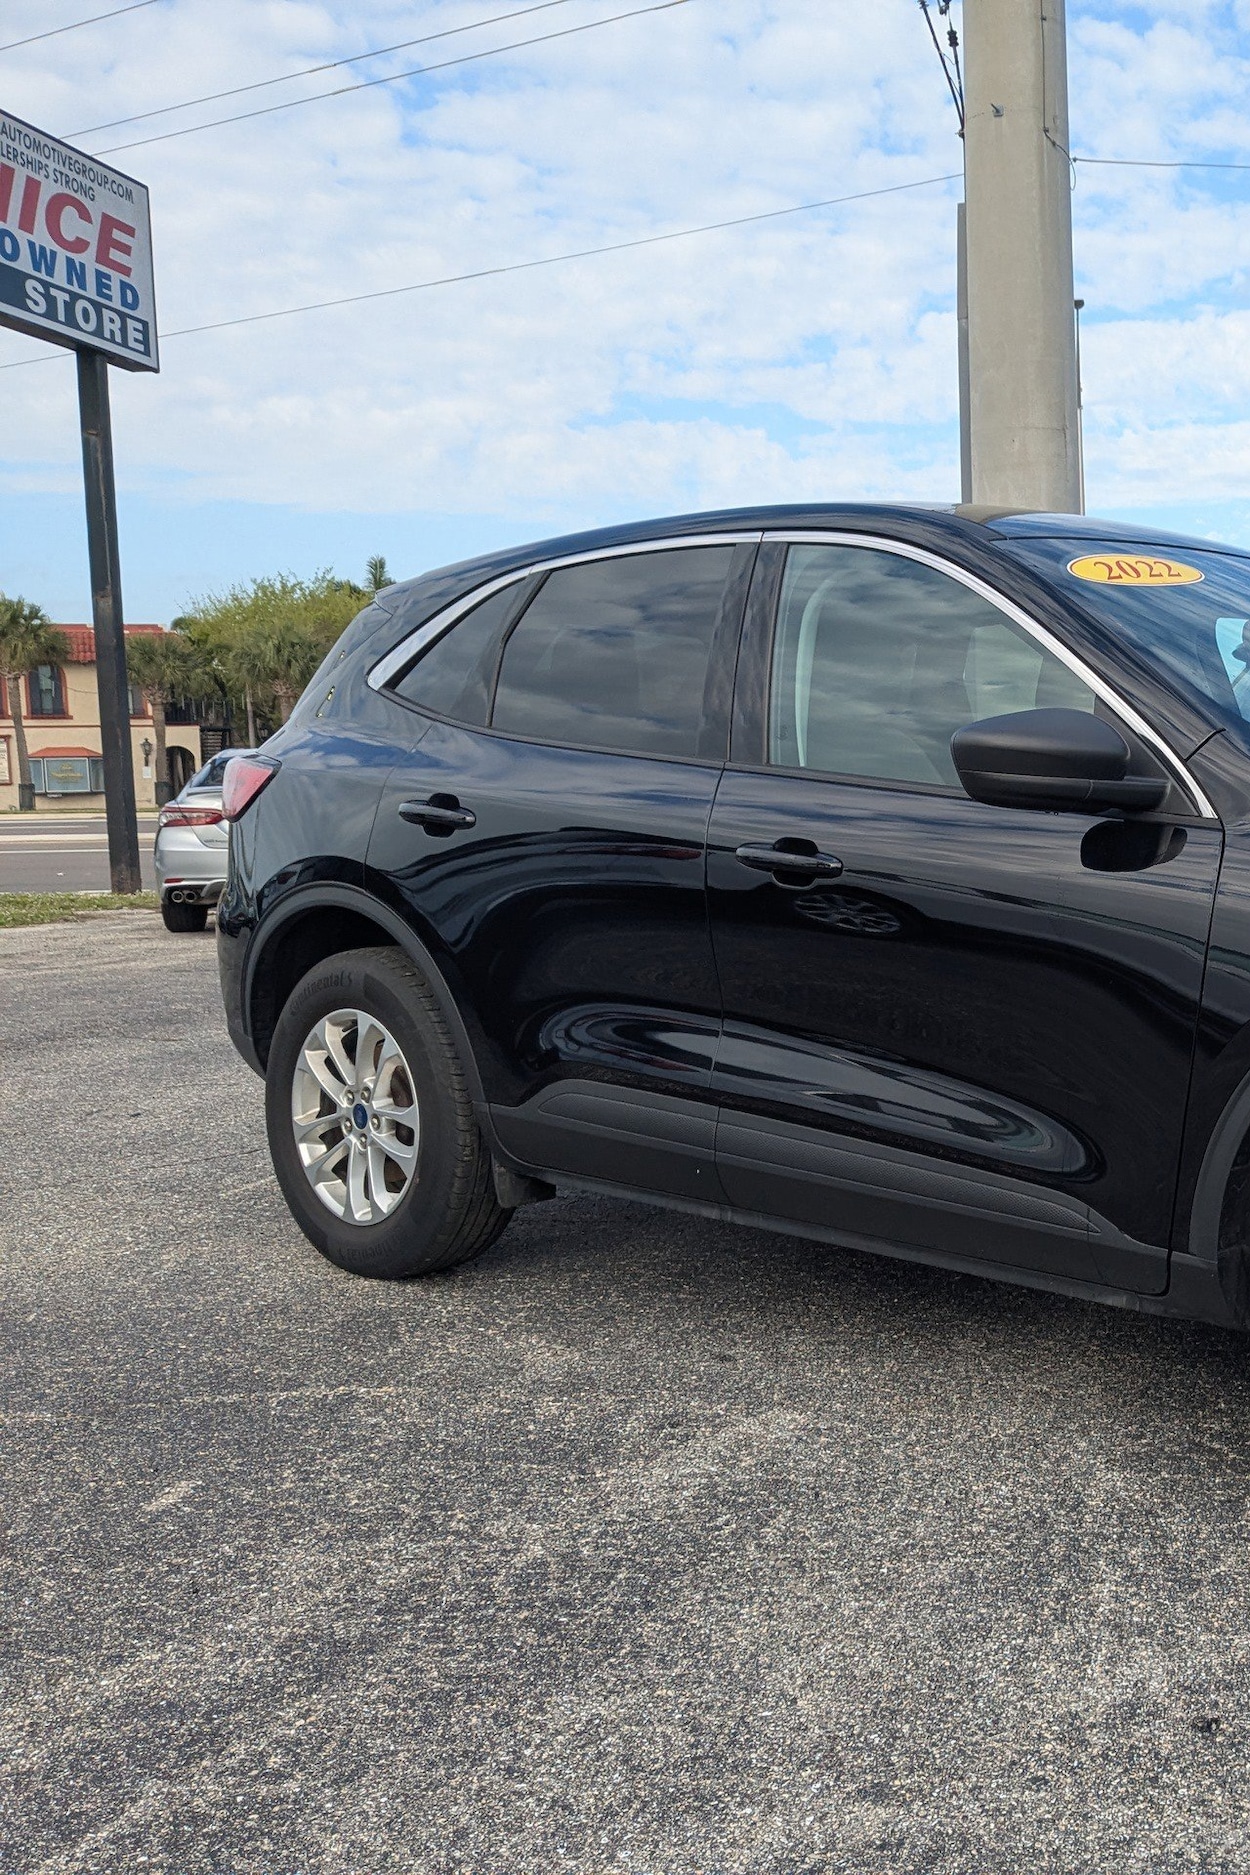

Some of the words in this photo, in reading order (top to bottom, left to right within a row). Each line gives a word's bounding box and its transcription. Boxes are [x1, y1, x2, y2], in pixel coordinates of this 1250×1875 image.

[0, 121, 134, 204] AUTOMOTIVEGROUP.COM
[0, 141, 50, 179] LERSHIPS
[53, 168, 96, 202] STRONG
[0, 228, 140, 312] OWNED
[25, 279, 145, 352] STORE
[1093, 560, 1182, 580] 2022
